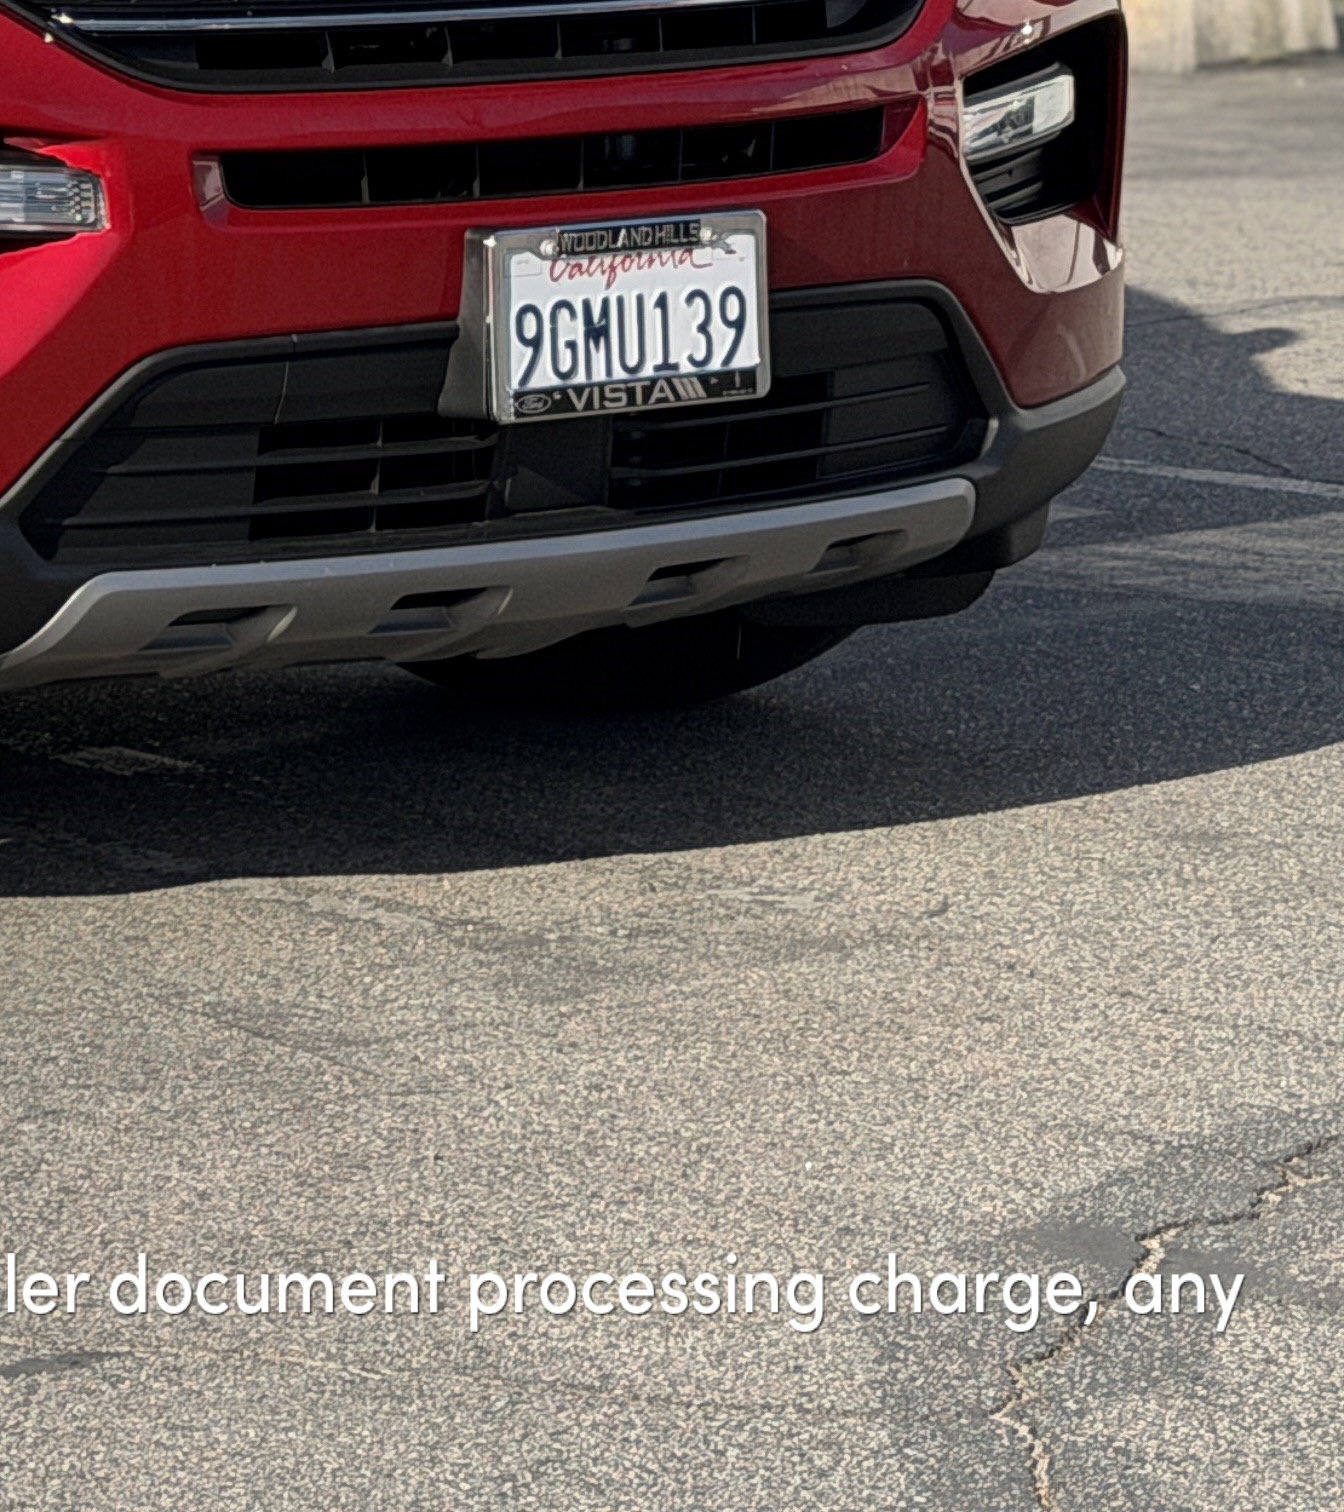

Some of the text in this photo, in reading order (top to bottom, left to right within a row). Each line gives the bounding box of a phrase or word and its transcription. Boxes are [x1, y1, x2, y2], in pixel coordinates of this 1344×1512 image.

[562, 221, 701, 254] WOODLAND HILLS
[549, 248, 713, 290] California
[514, 285, 747, 388] 9GMU139
[566, 378, 676, 412] VISTA
